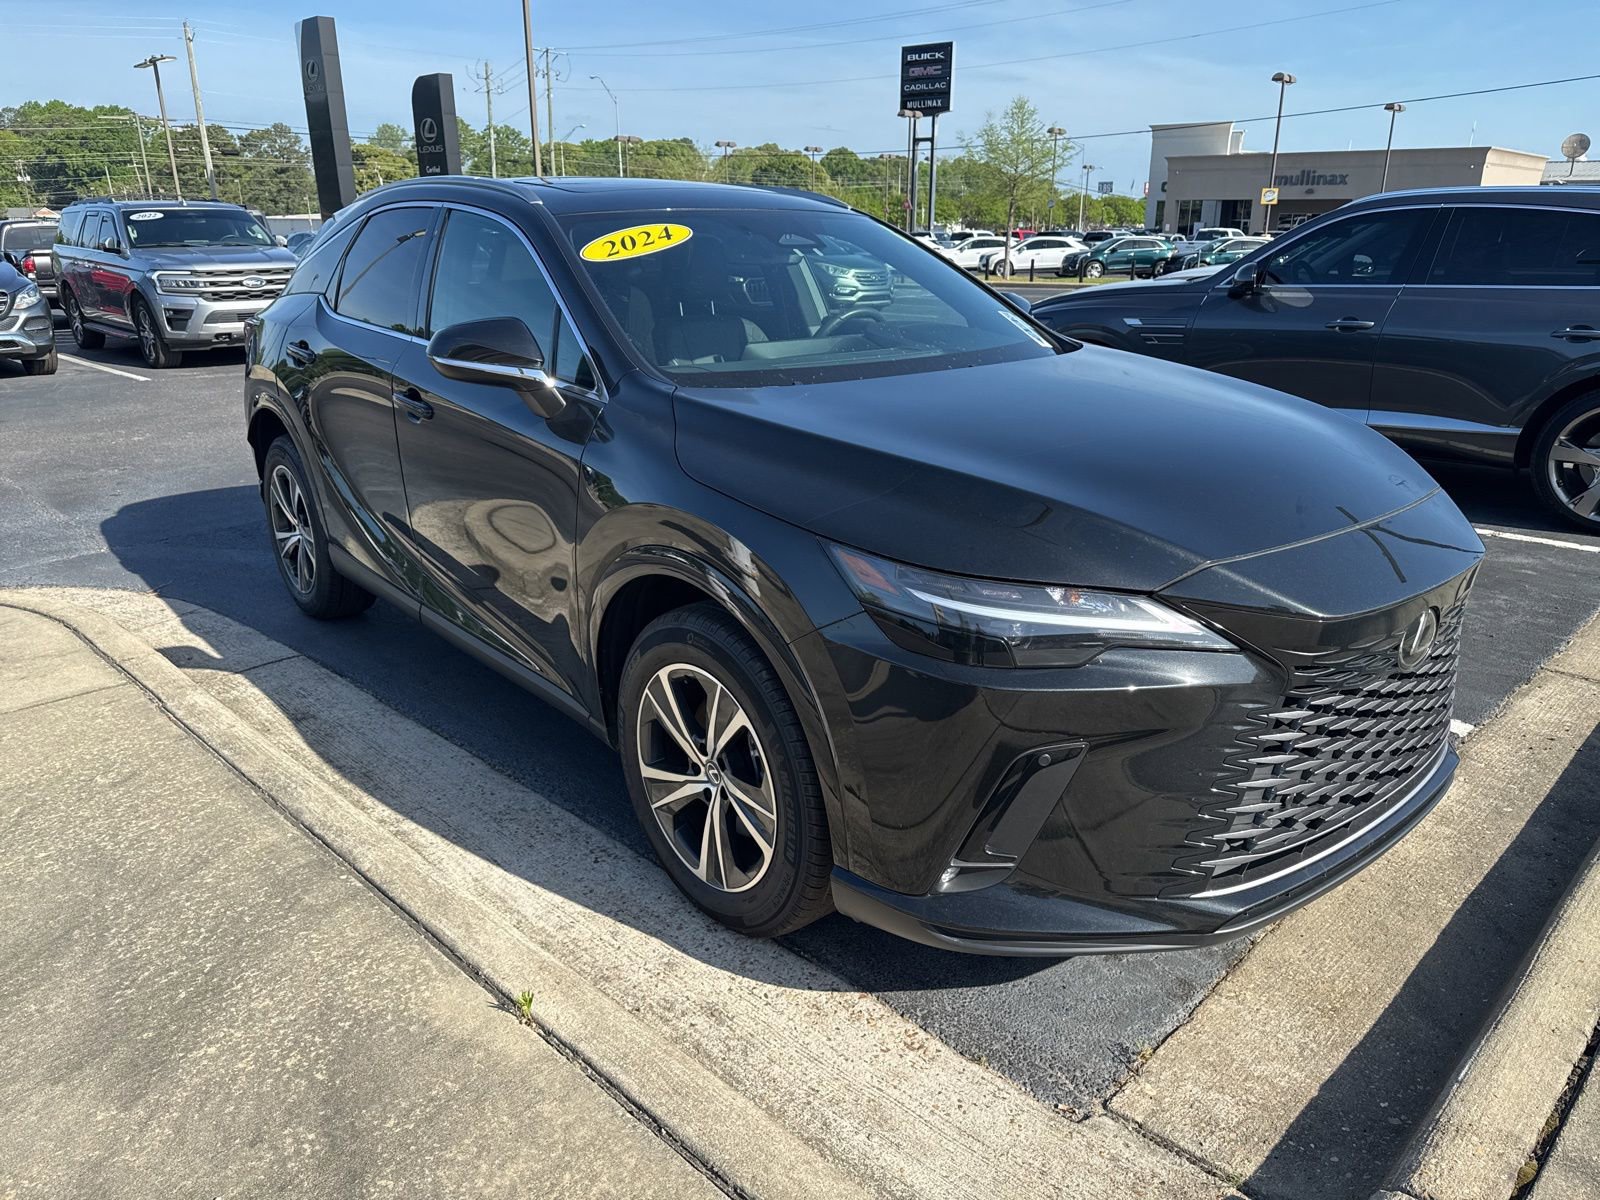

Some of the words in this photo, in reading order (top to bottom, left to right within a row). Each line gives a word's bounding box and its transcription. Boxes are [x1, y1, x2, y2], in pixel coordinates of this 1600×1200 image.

[907, 51, 945, 61] BUICK
[909, 65, 942, 76] GMC
[904, 82, 946, 91] CADILLAC
[906, 99, 942, 108] MULLINAX
[418, 145, 444, 154] LEXUS
[1273, 169, 1349, 187] mullinax
[602, 225, 673, 257] 2024
[780, 770, 797, 864] MICHELIN
